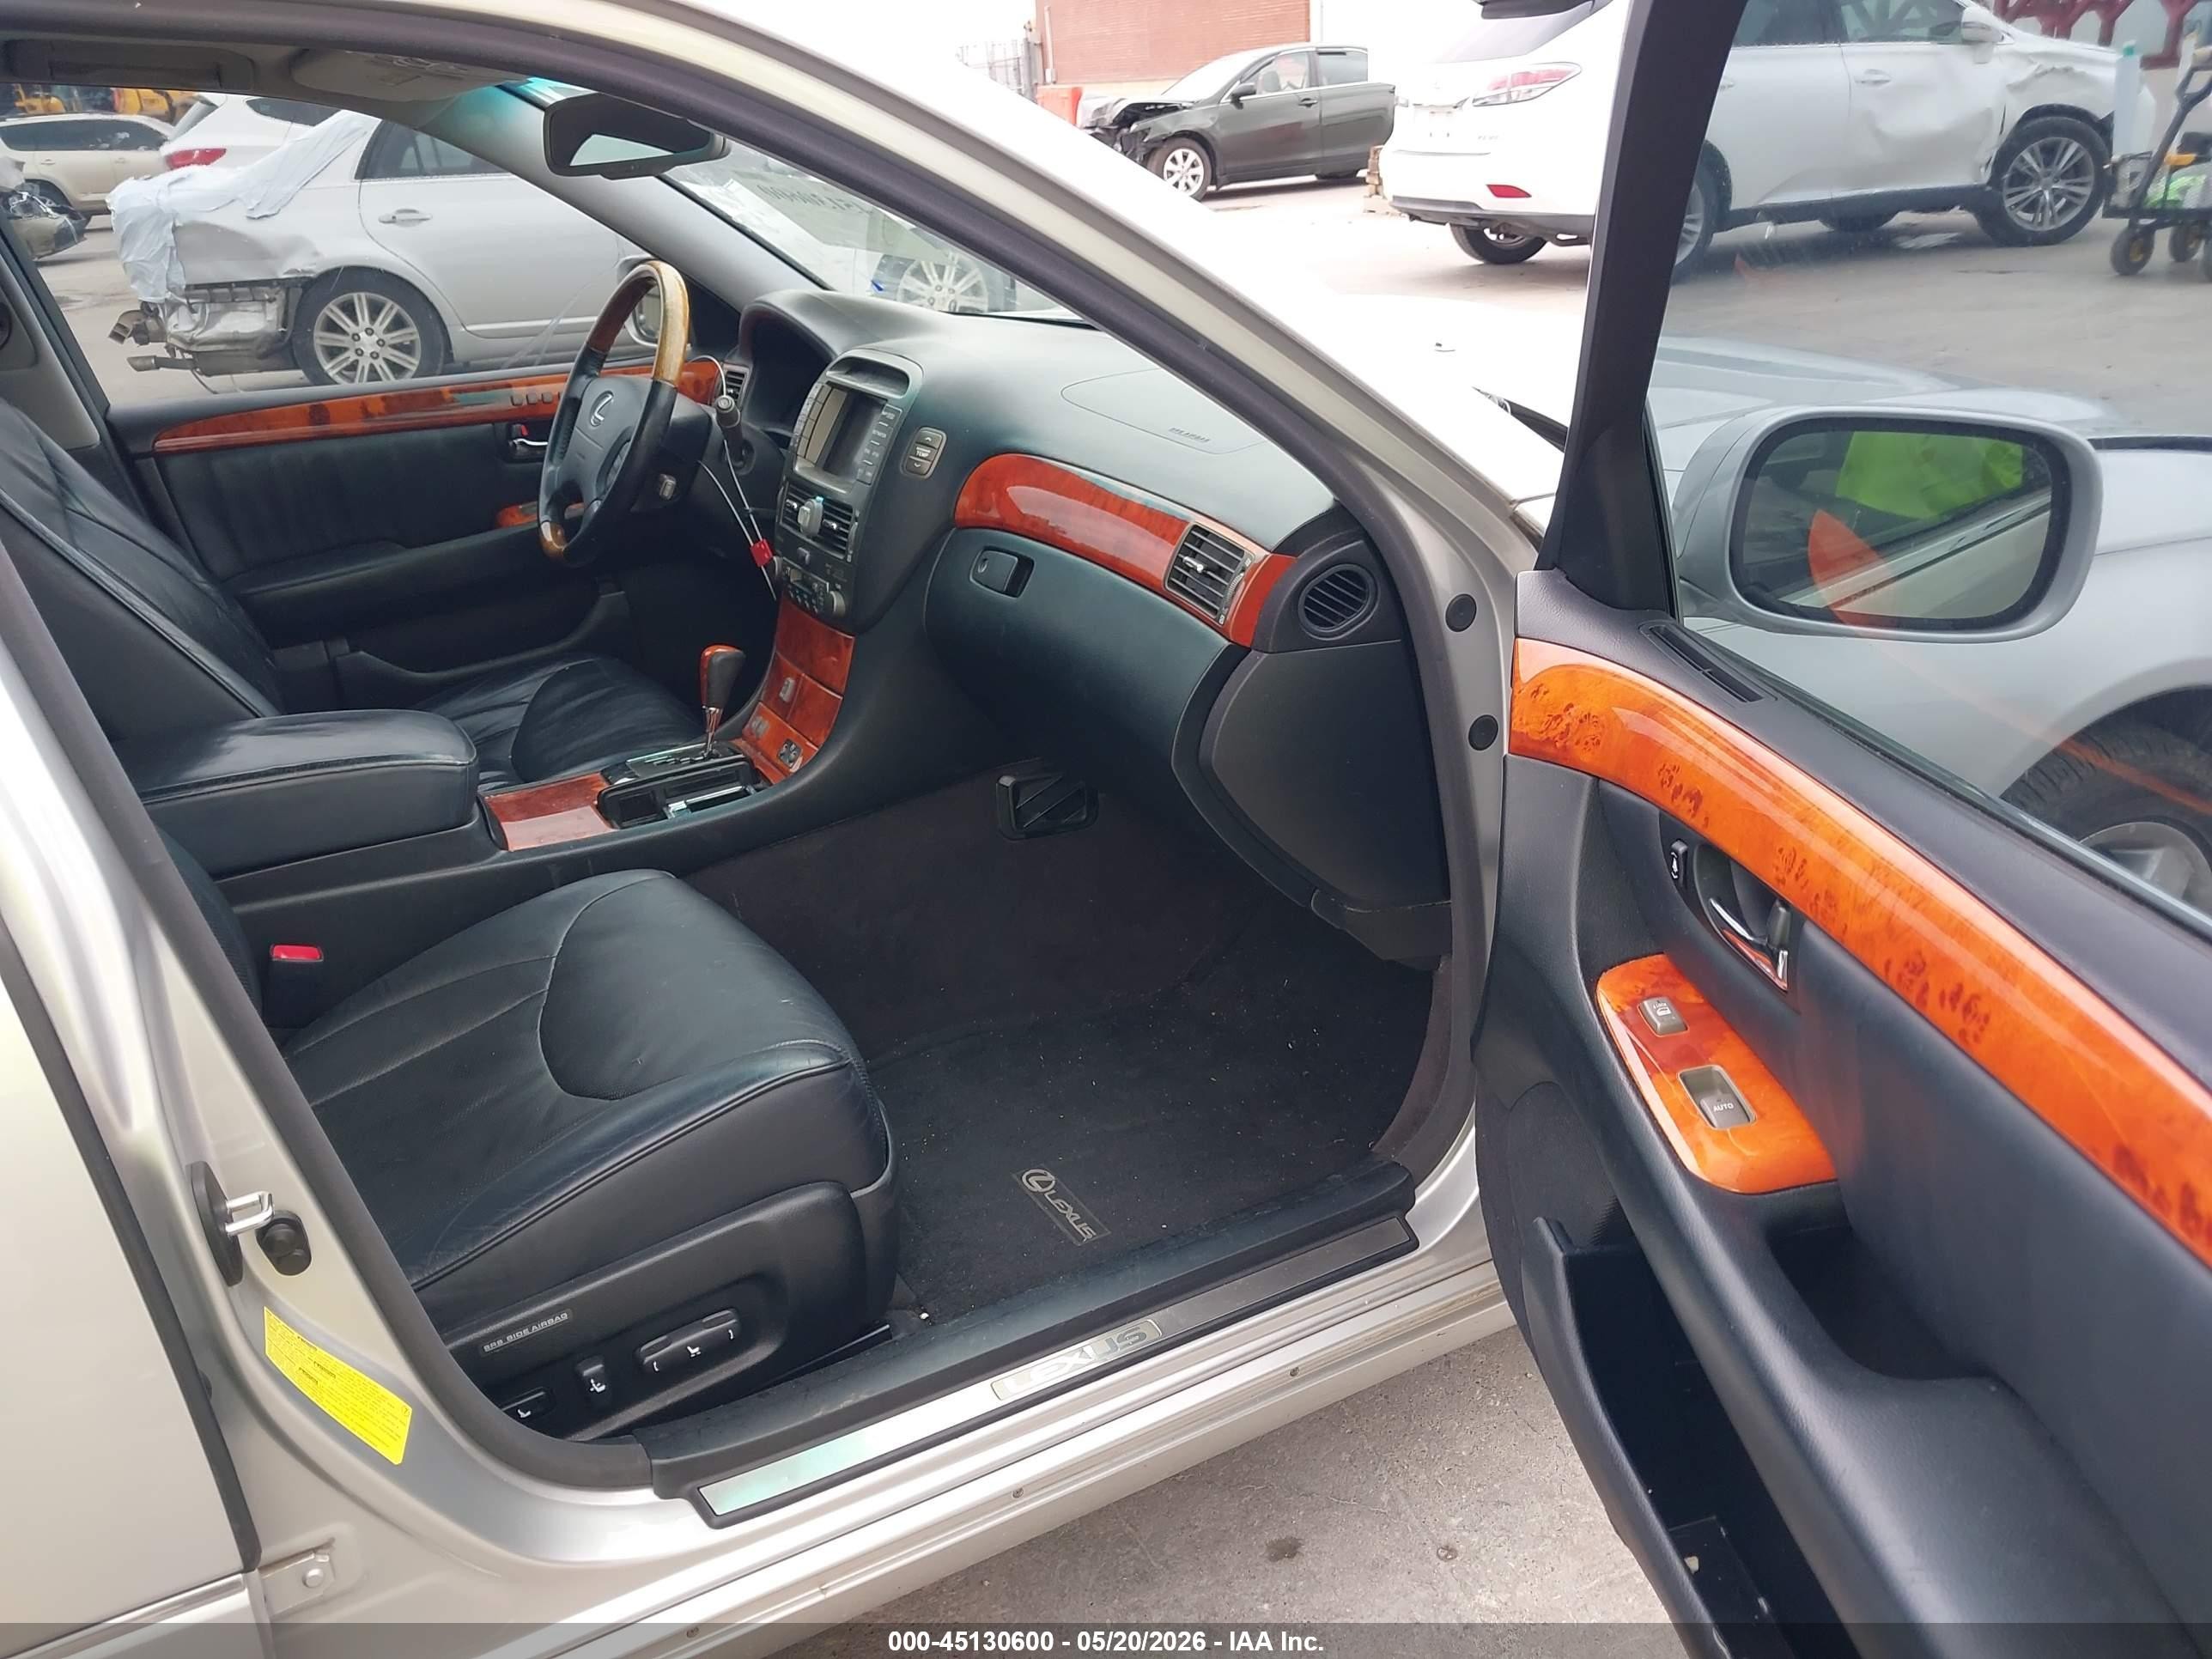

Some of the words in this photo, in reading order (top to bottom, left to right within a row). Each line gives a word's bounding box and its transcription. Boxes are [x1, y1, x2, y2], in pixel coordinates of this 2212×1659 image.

[1713, 1103, 1735, 1112] AUTO
[1044, 1189, 1097, 1242] LEXUS
[483, 1339, 504, 1352] SRS
[506, 1328, 530, 1342] SIDE
[532, 1312, 568, 1333] AIRBAG
